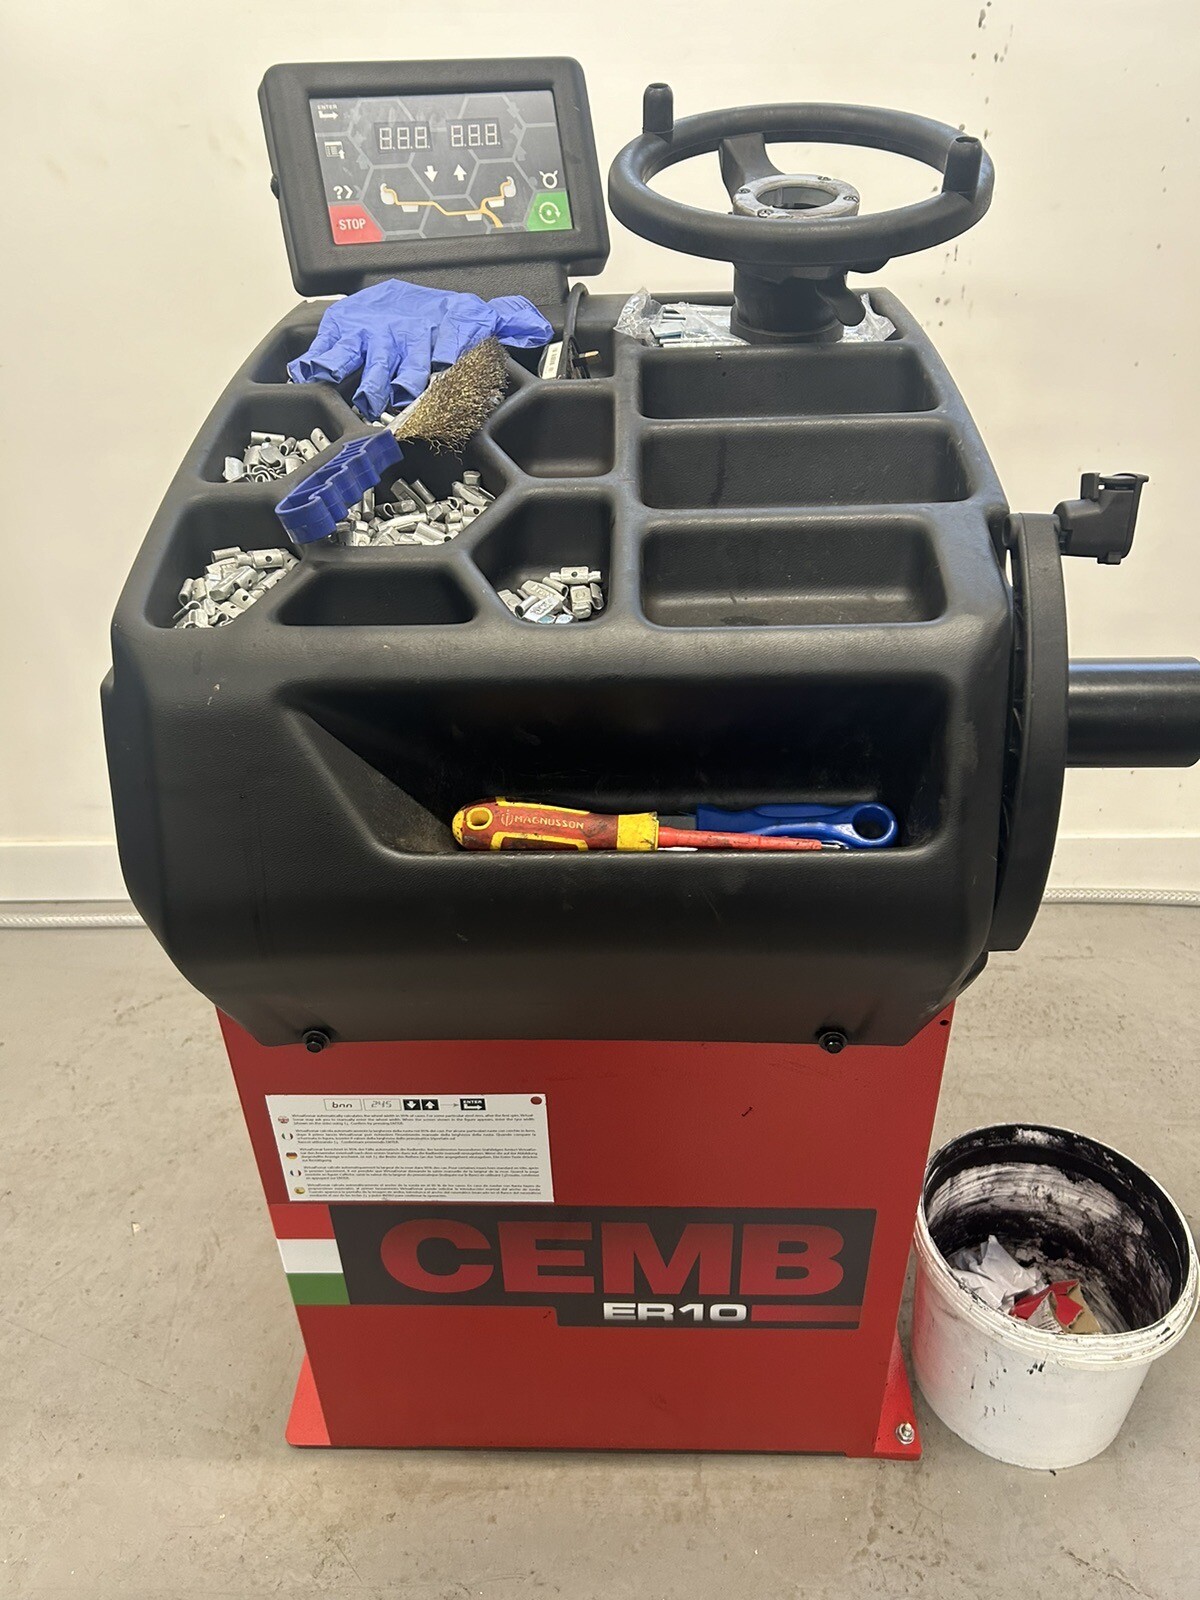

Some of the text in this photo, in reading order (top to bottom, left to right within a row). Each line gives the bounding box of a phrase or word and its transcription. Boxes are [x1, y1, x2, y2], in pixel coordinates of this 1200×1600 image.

[339, 218, 366, 231] STOP
[514, 815, 585, 830] MAGNUSSON
[380, 1218, 845, 1296] CEMB
[603, 1302, 748, 1323] ER10
